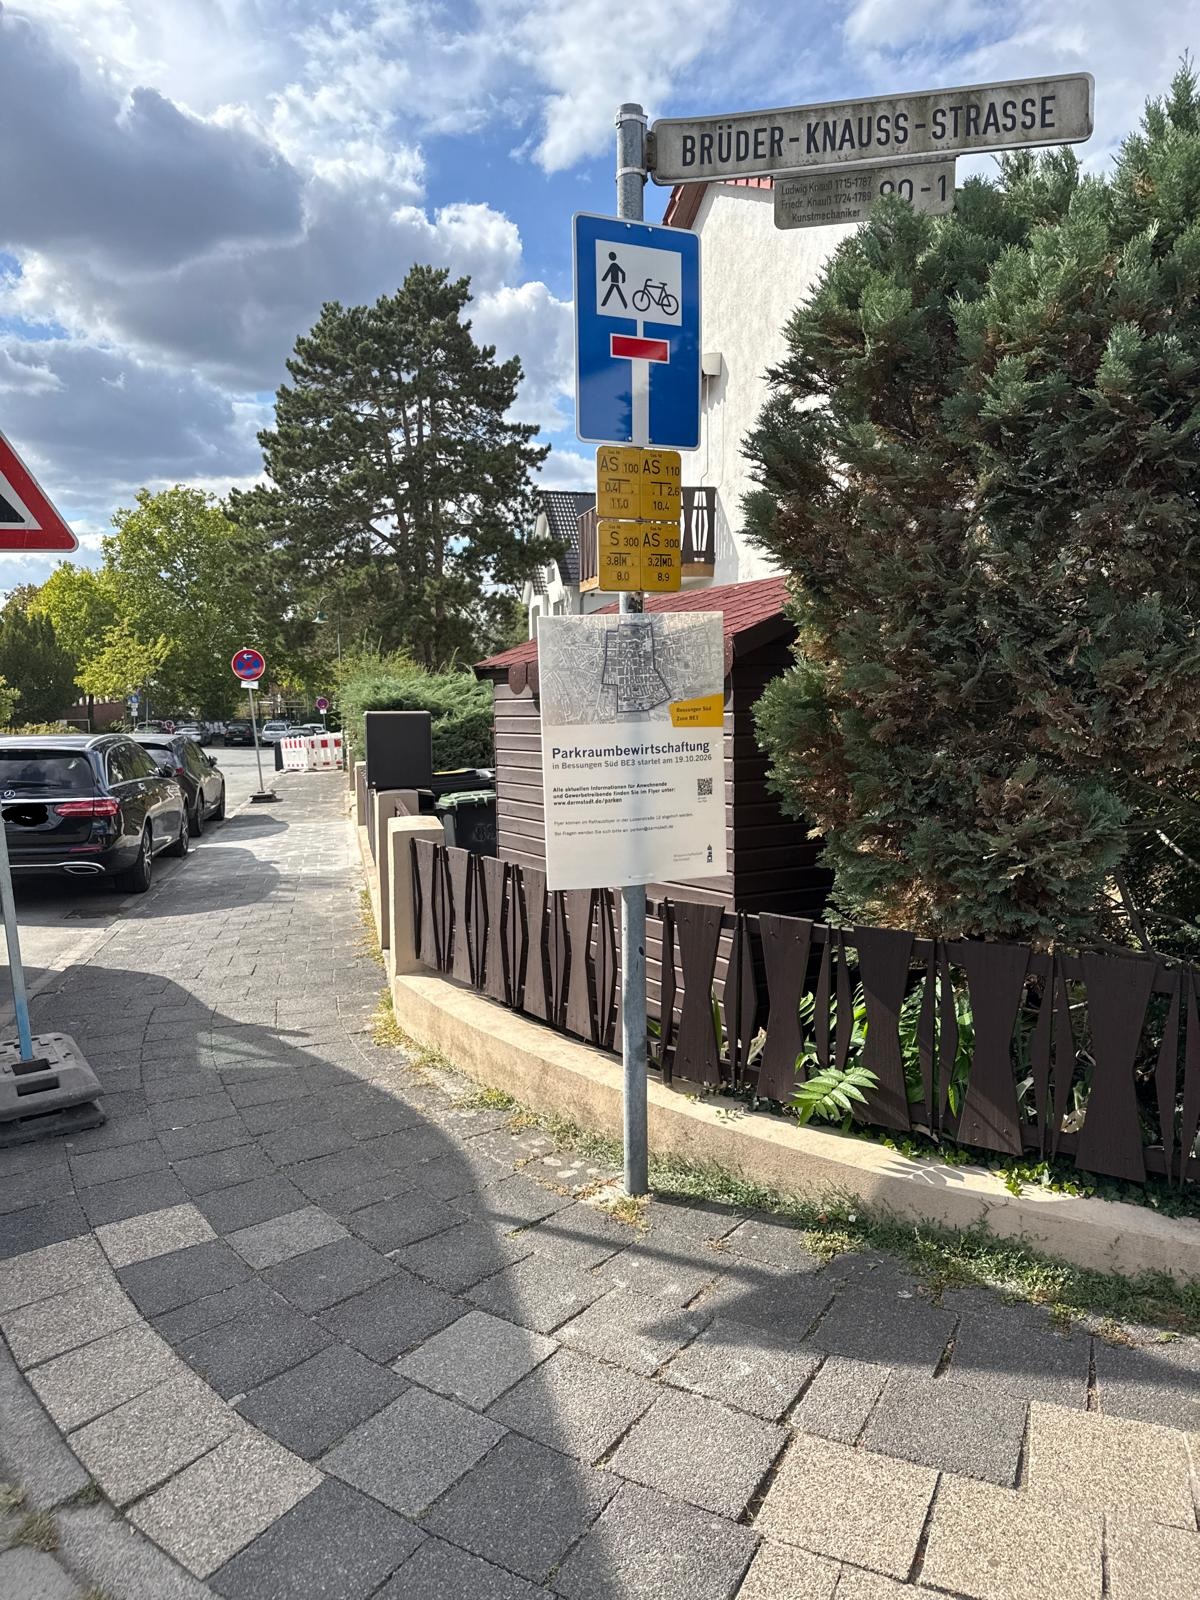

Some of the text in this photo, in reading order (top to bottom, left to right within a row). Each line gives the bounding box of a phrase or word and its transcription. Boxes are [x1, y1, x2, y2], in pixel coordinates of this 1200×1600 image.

[682, 95, 1056, 167] BRÜDER-KNAUSS-STRASSE
[781, 183, 807, 197] Ludwig
[791, 207, 861, 223] Kunstmechaniker
[600, 455, 639, 474] AS 100
[643, 458, 680, 477] AS 110
[610, 531, 639, 547] S 300
[643, 532, 680, 549] AS 300
[552, 741, 710, 759] Parkraumbewirtschaftung
[552, 762, 560, 770] in
[561, 762, 603, 770] Bessungen
[604, 759, 619, 768] Süd
[620, 758, 636, 767] BE3
[637, 757, 661, 766] startet
[674, 753, 713, 763] 19.10.2026
